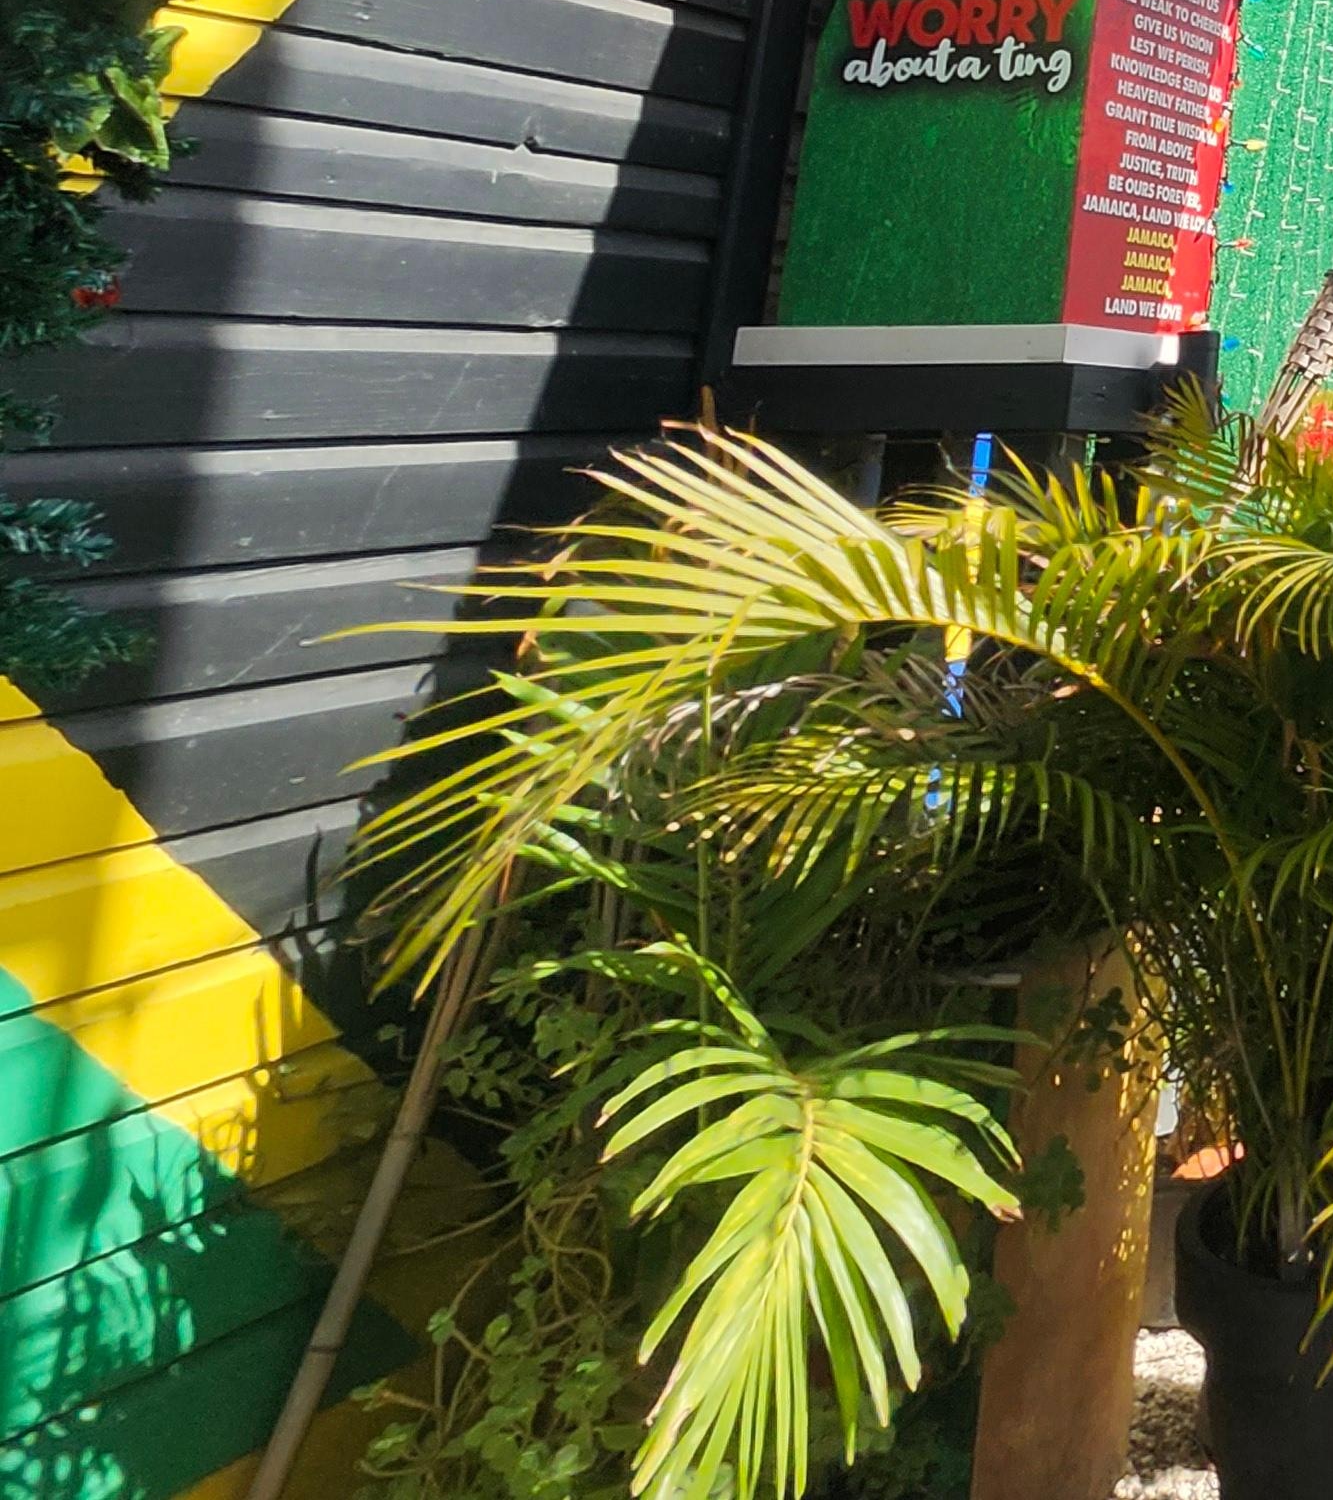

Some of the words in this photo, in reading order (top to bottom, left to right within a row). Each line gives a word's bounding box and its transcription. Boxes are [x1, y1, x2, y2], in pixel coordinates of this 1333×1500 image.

[1175, 4, 1189, 23] TO
[1134, 13, 1163, 37] GIVE
[1163, 23, 1179, 42] US
[1180, 29, 1214, 56] VISION
[843, 37, 957, 88] about
[955, 57, 991, 81] a
[993, 35, 1073, 93] ting
[1130, 35, 1156, 58] LEST
[1157, 44, 1175, 63] WE
[1174, 50, 1212, 79] PERISH,
[1111, 52, 1182, 90] KNOWLEDGE
[1182, 76, 1208, 98] SEND
[1207, 85, 1223, 104] US
[1117, 78, 1175, 110] HEAVENLY
[1105, 100, 1148, 126] GRANT
[1149, 112, 1177, 134] TRUE
[1125, 129, 1157, 152] FROM
[1158, 139, 1196, 164] ABOVE,
[1108, 173, 1124, 193] BE
[1124, 177, 1156, 200] OURS
[1119, 152, 1166, 180] JUSTICE,
[1165, 163, 1200, 187] TRUTH
[1082, 194, 1141, 222] JAMAICA,
[1142, 205, 1173, 226] LAND
[1173, 211, 1190, 230] WE
[1126, 226, 1178, 253] JAMAICA,
[1123, 250, 1176, 277] JAMAICA,
[1121, 274, 1174, 300] JAMAICA,
[1104, 296, 1137, 316] LAND
[1139, 300, 1156, 319] WE
[1155, 303, 1183, 321] LOVE
